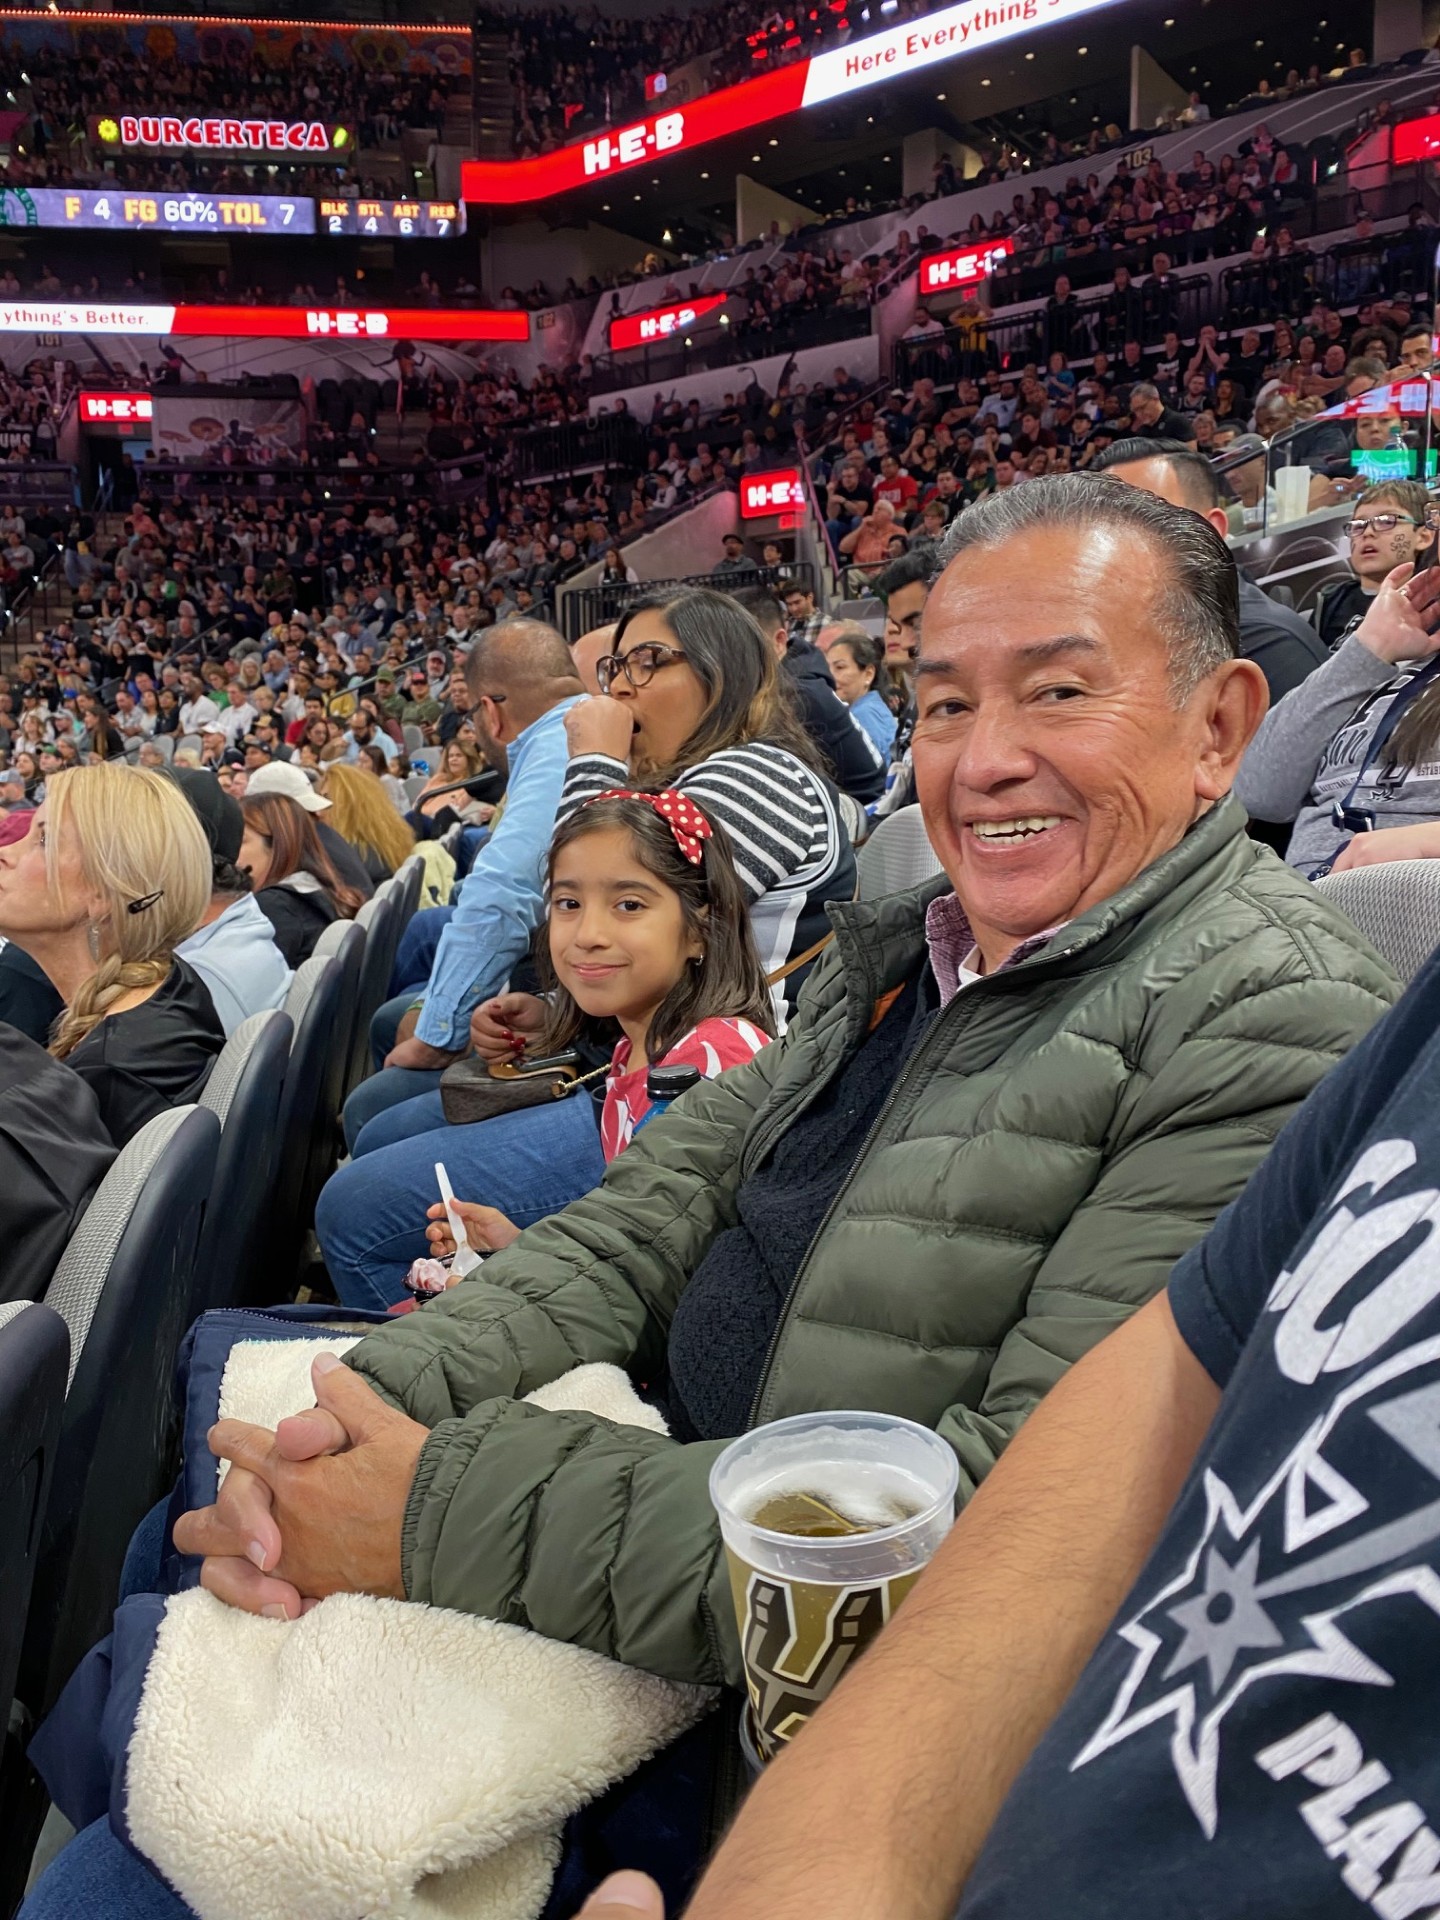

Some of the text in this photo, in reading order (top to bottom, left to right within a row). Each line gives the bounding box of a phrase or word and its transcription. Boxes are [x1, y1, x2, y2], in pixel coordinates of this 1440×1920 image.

[846, 0, 1060, 77] Here Everything
[121, 116, 329, 151] BURGERTECA
[65, 197, 295, 226] F 4 FG 60% TOL 7
[321, 202, 349, 216] BLK
[393, 204, 420, 218] AST
[329, 216, 449, 235] 2 4 6 7
[86, 311, 149, 325] Better.
[1254, 1711, 1440, 1920] PLAY
